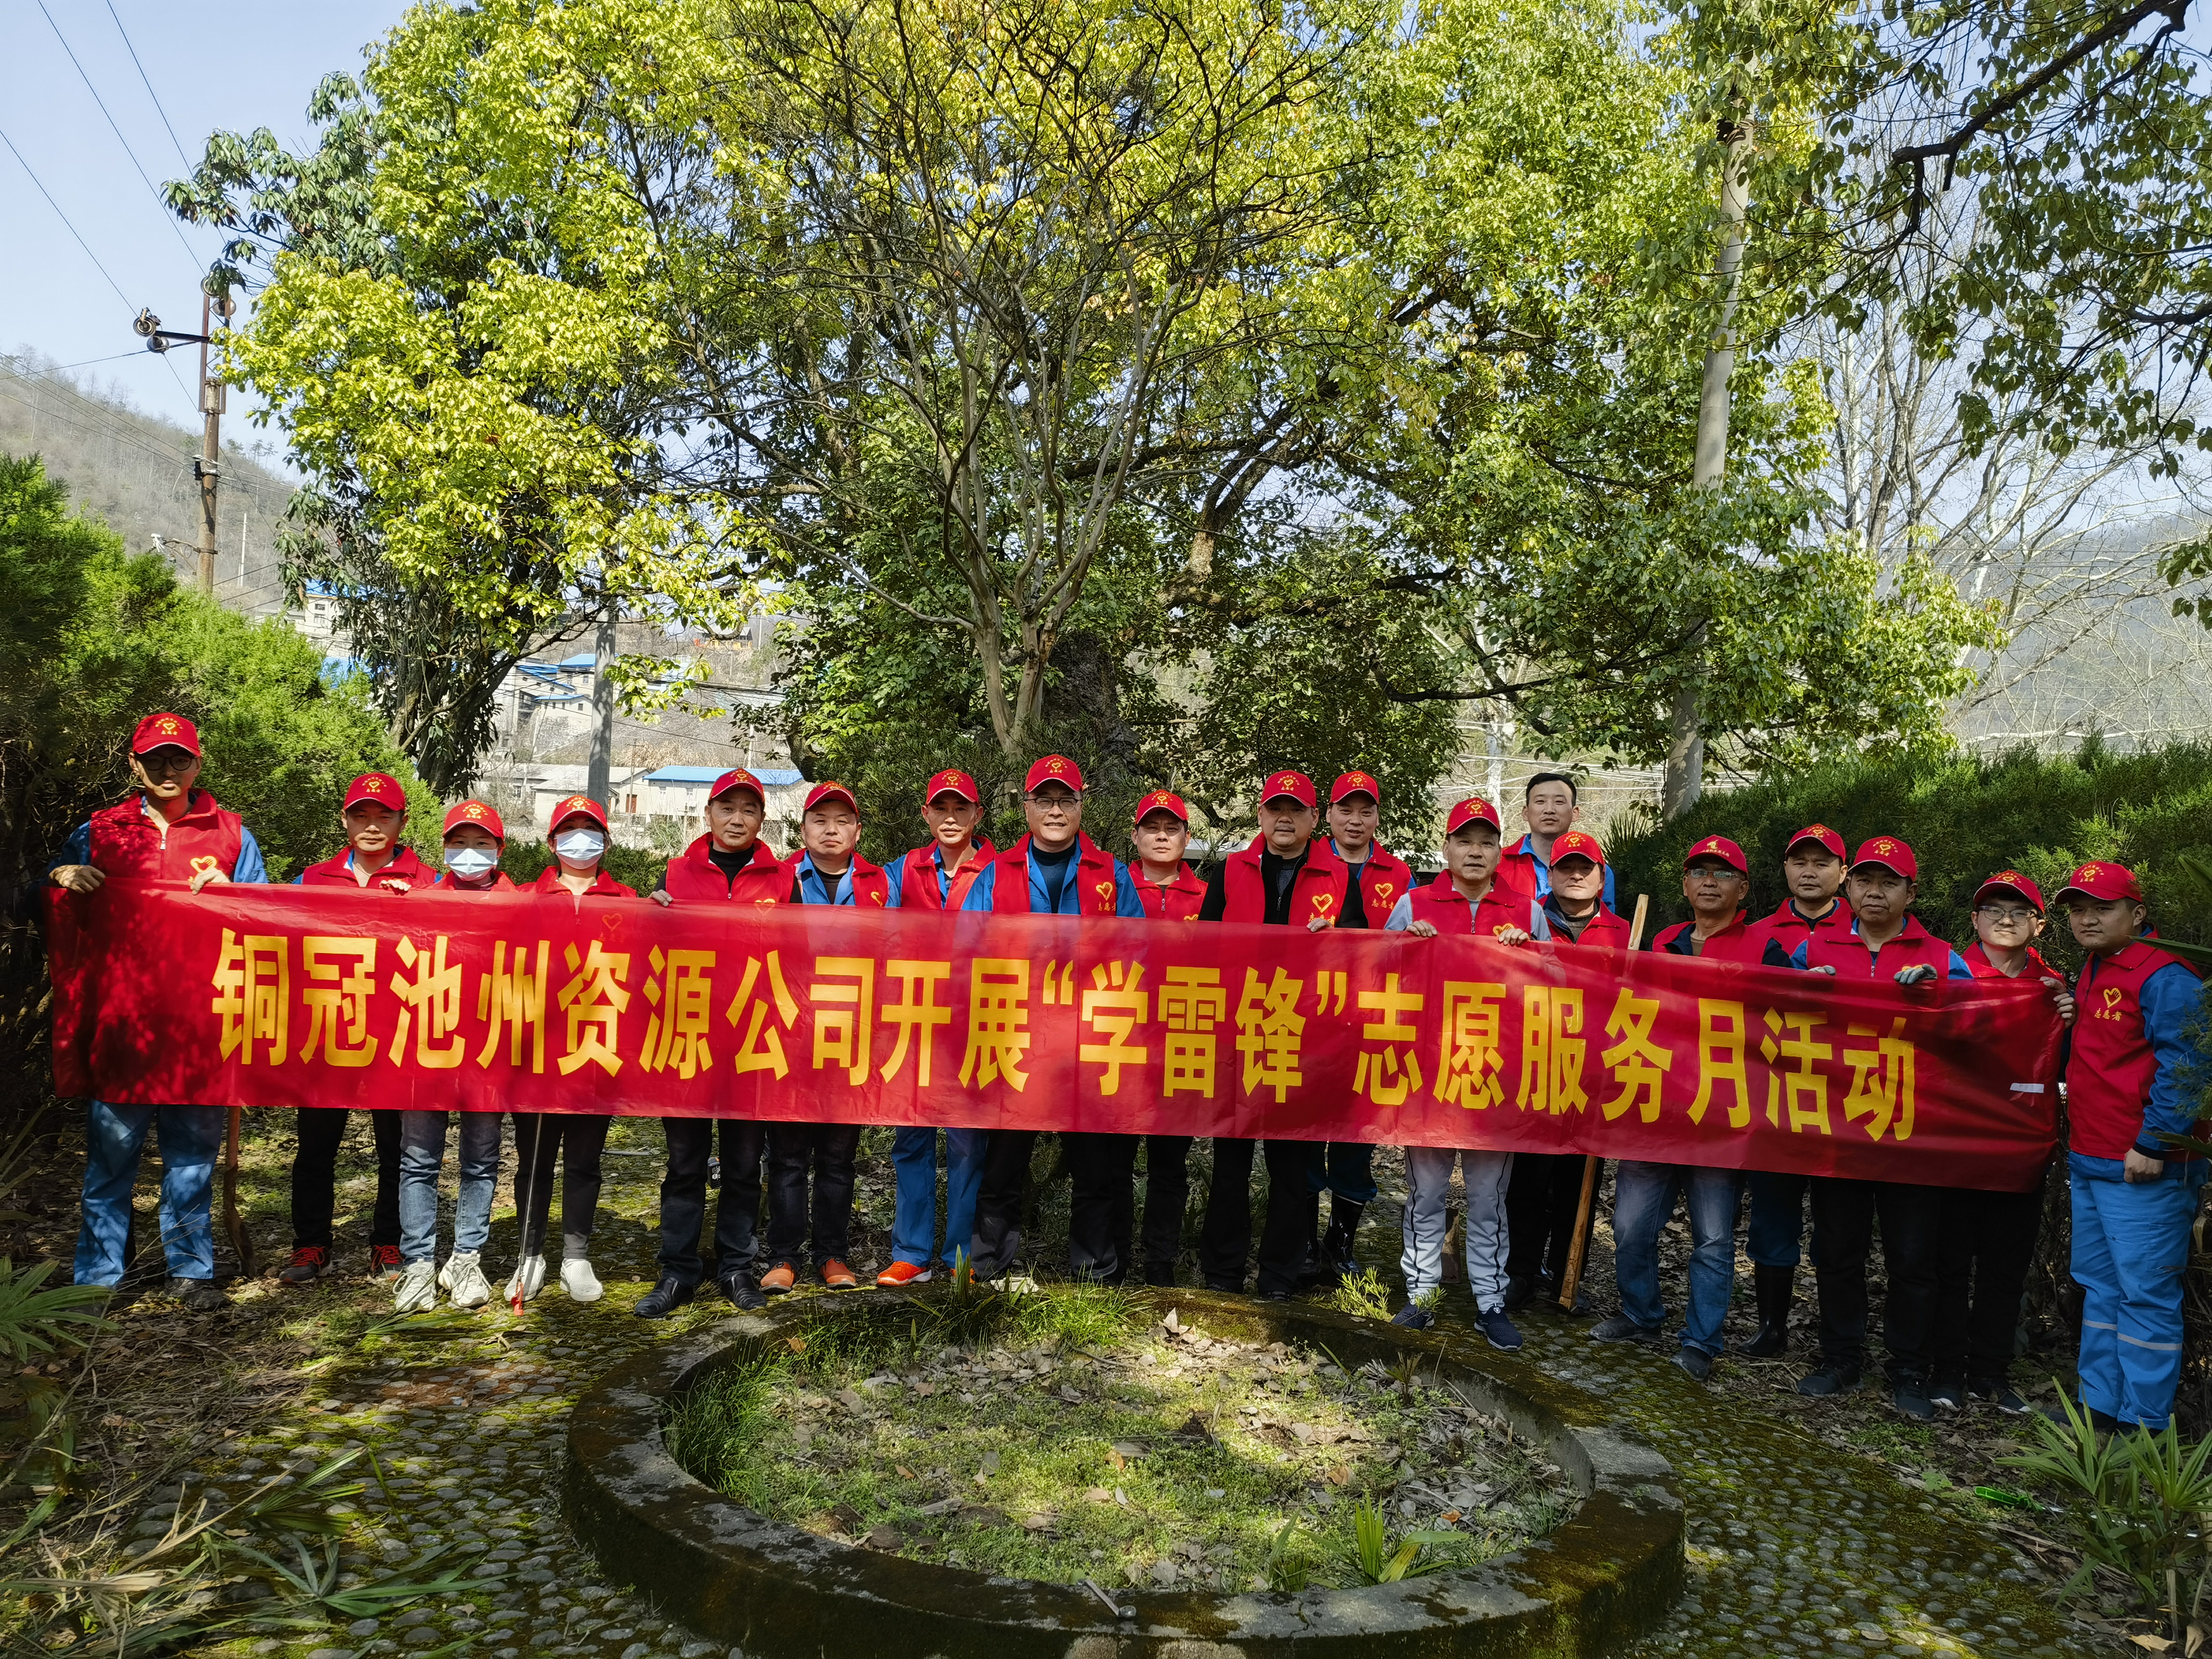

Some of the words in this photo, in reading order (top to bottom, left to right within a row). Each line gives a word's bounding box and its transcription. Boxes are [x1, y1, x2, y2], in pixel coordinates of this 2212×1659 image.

[211, 927, 1915, 1141] 铜冠池州资源公司开展“学雷锋”志愿服务月活动
[2094, 1008, 2122, 1021] 志愿者
